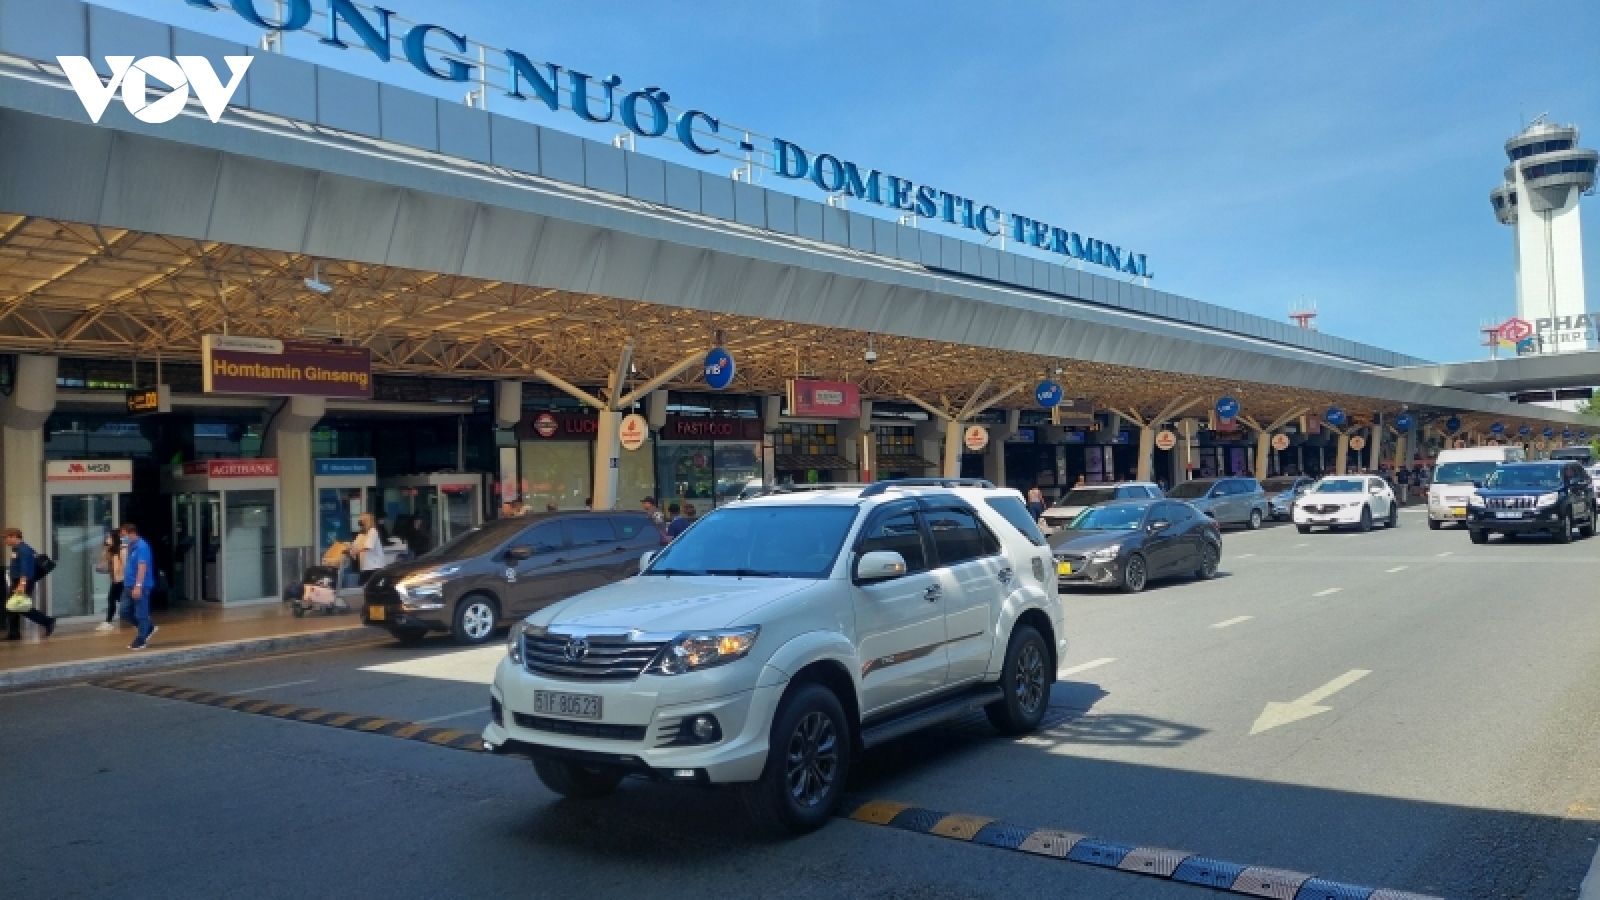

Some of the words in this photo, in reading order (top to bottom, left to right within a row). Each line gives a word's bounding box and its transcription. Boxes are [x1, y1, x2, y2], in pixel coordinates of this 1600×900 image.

[184, 0, 477, 82] ONG
[504, 47, 720, 155] NƯỚC
[772, 136, 1001, 237] DOMESTIC
[1011, 213, 1154, 279] TERMINAL
[213, 359, 301, 382] Homtamin
[304, 365, 369, 391] Ginseng
[87, 463, 111, 473] MSB
[211, 463, 274, 475] AGRIBANK
